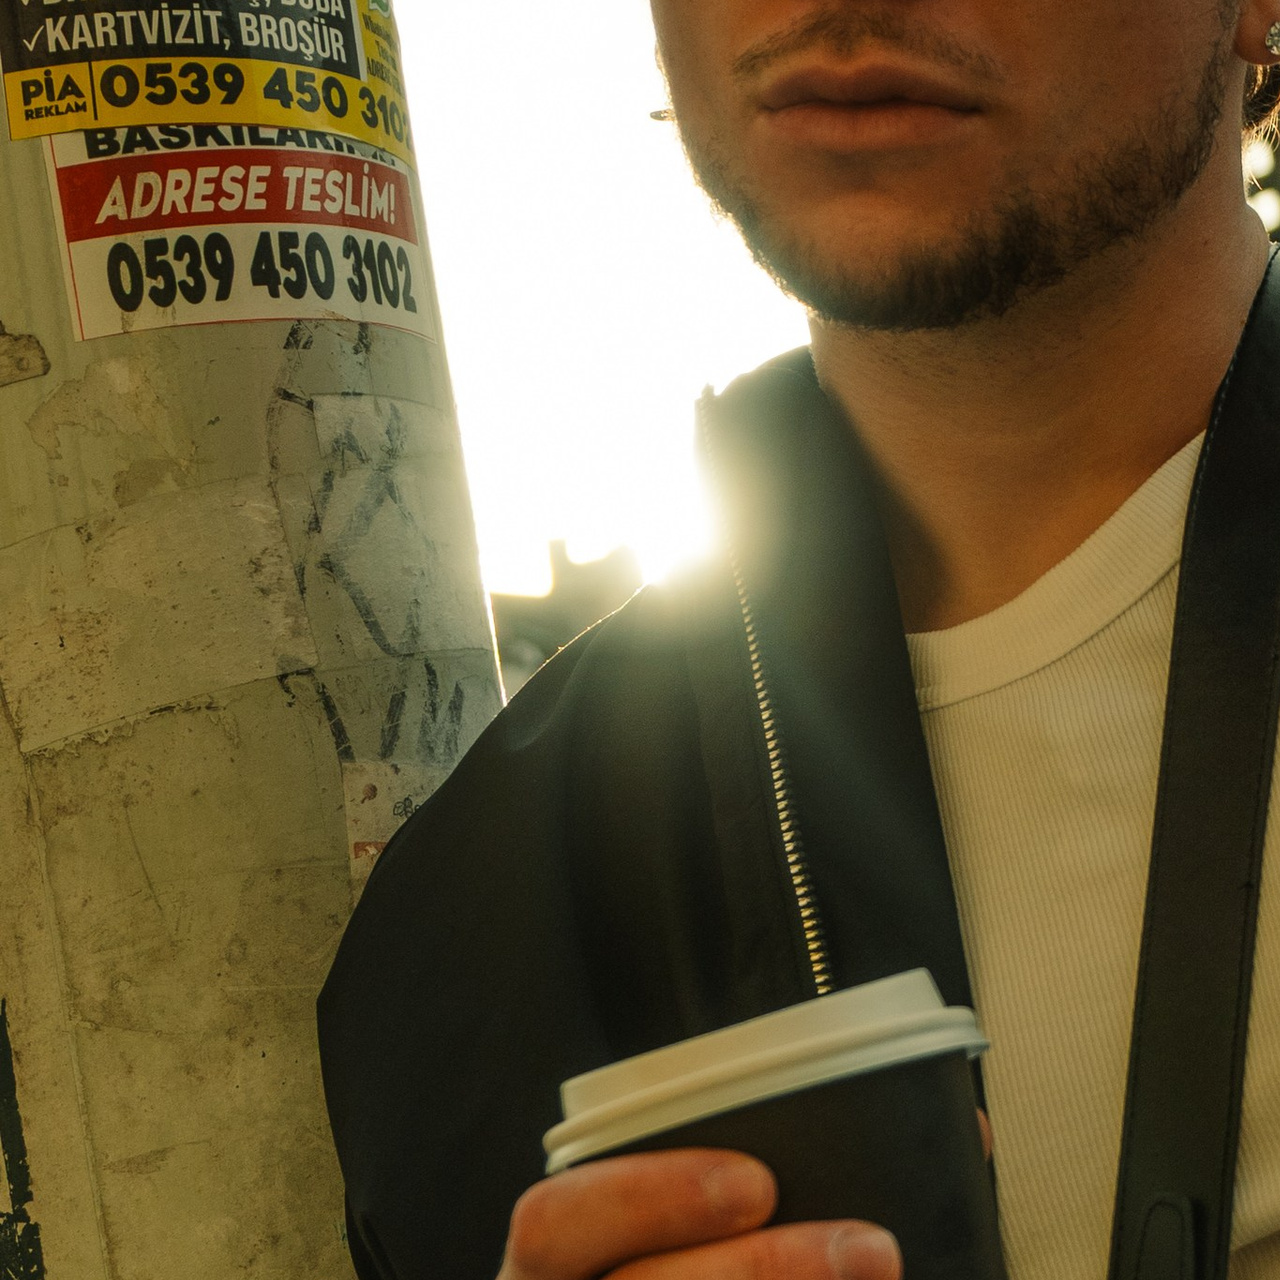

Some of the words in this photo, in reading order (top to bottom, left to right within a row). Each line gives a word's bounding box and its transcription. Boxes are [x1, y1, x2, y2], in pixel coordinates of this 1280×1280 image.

[45, 2, 231, 53] KARTVİZİT,
[238, 11, 348, 64] BROŞÜR
[24, 100, 88, 122] REKLAM
[100, 61, 245, 109] 0539
[263, 67, 349, 119] 450
[95, 165, 271, 224] ADRESE
[282, 162, 397, 225] TESLİM!
[107, 232, 235, 313] 0539
[250, 231, 335, 301] 450
[342, 234, 418, 314] 3102
